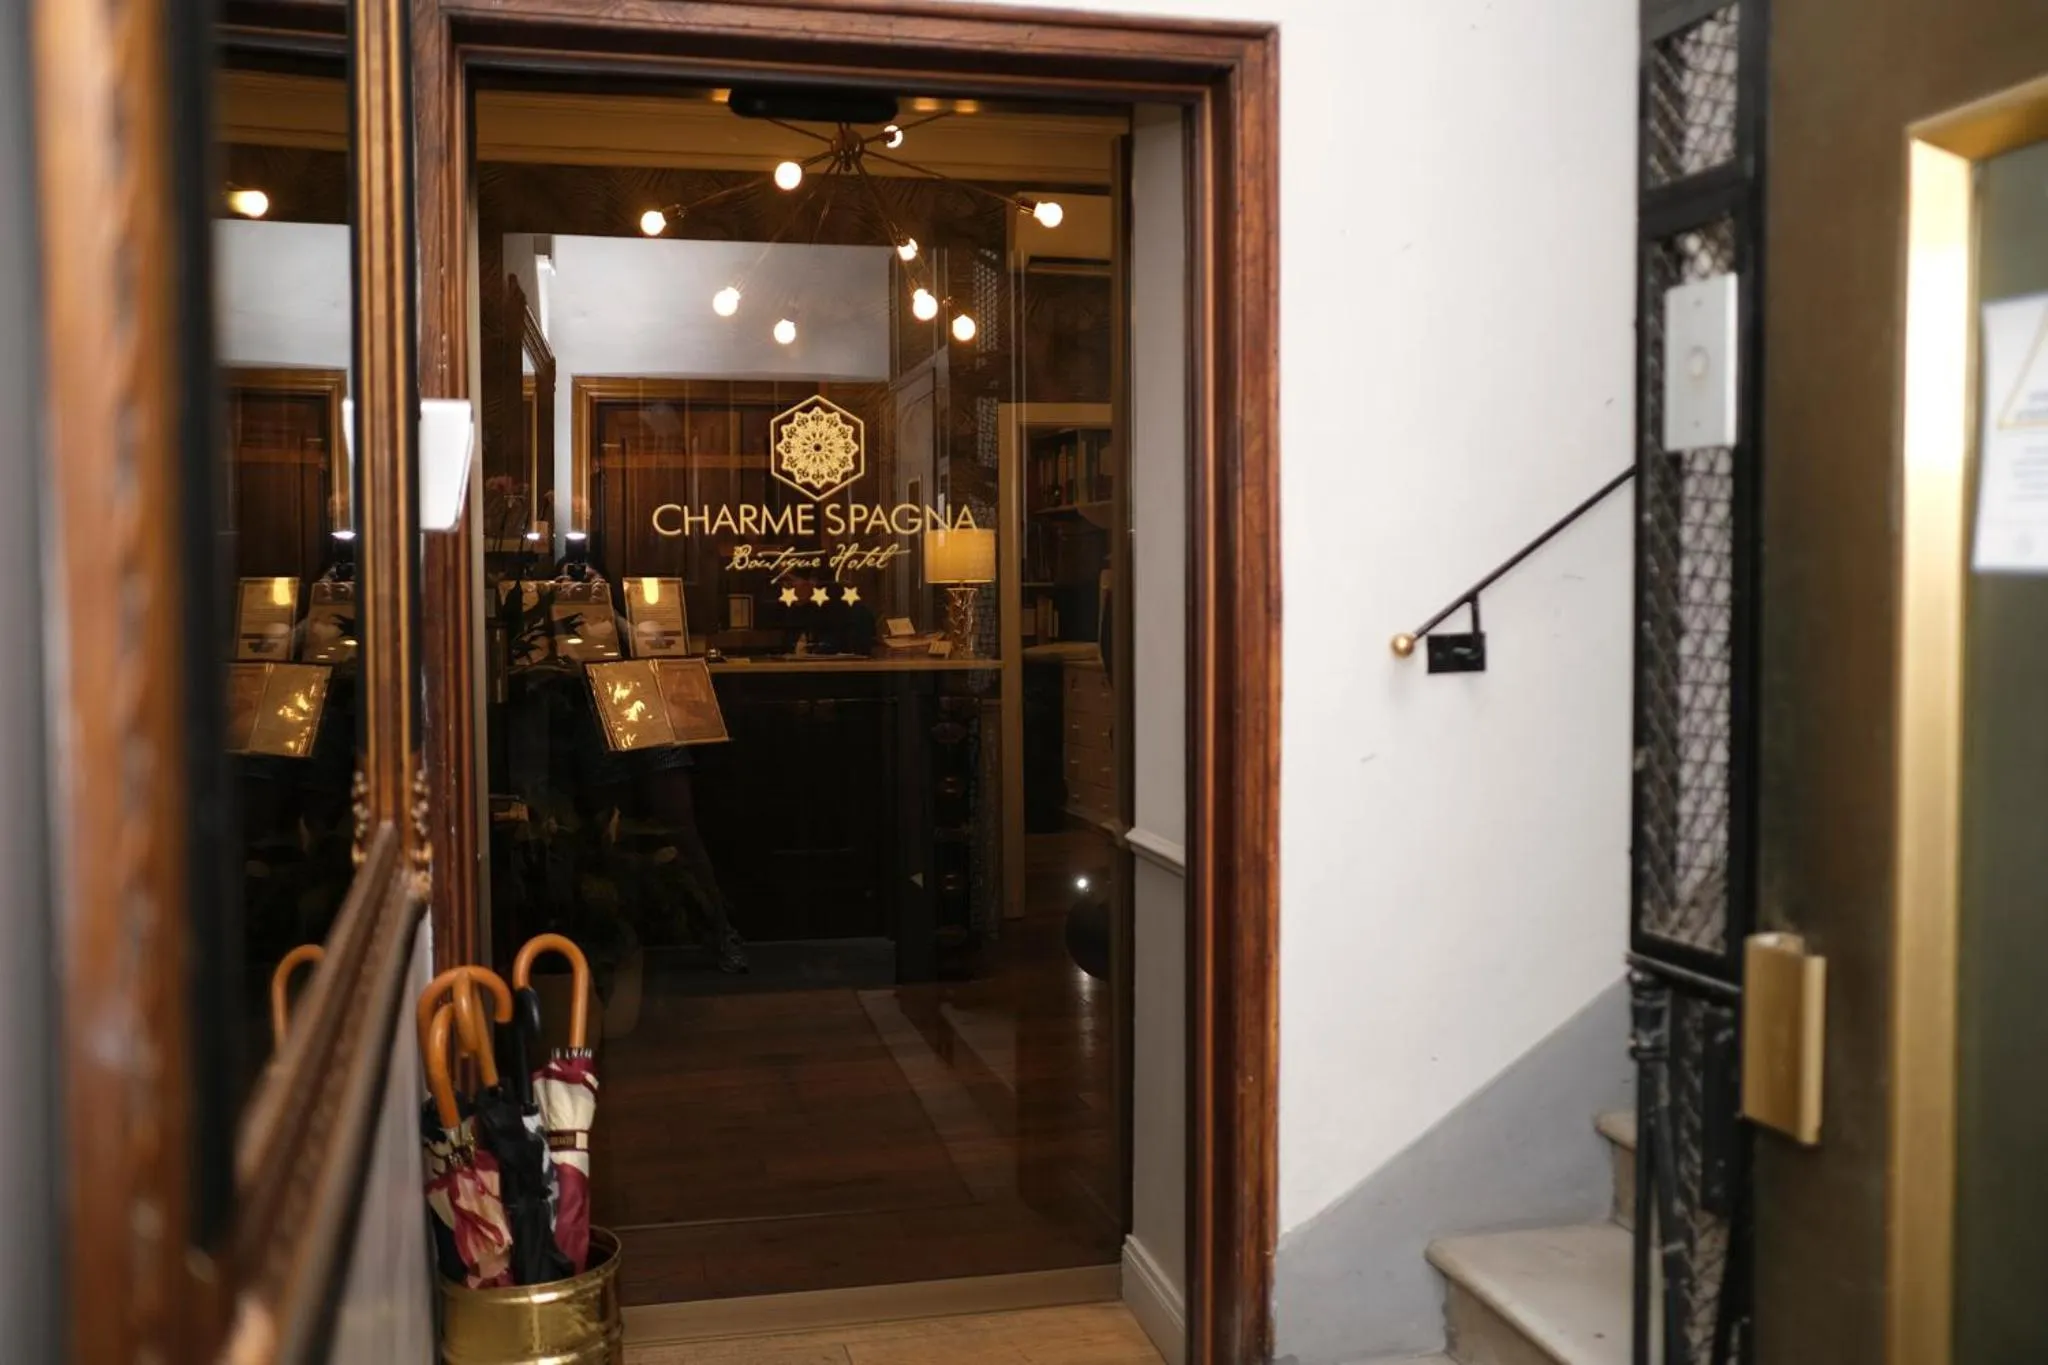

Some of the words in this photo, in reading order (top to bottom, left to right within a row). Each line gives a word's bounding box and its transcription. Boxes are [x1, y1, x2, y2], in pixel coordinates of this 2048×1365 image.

[652, 503, 815, 535] CHARME
[825, 503, 977, 535] SPAGNA
[725, 544, 825, 584] Boutique
[829, 542, 911, 582] Hotel
